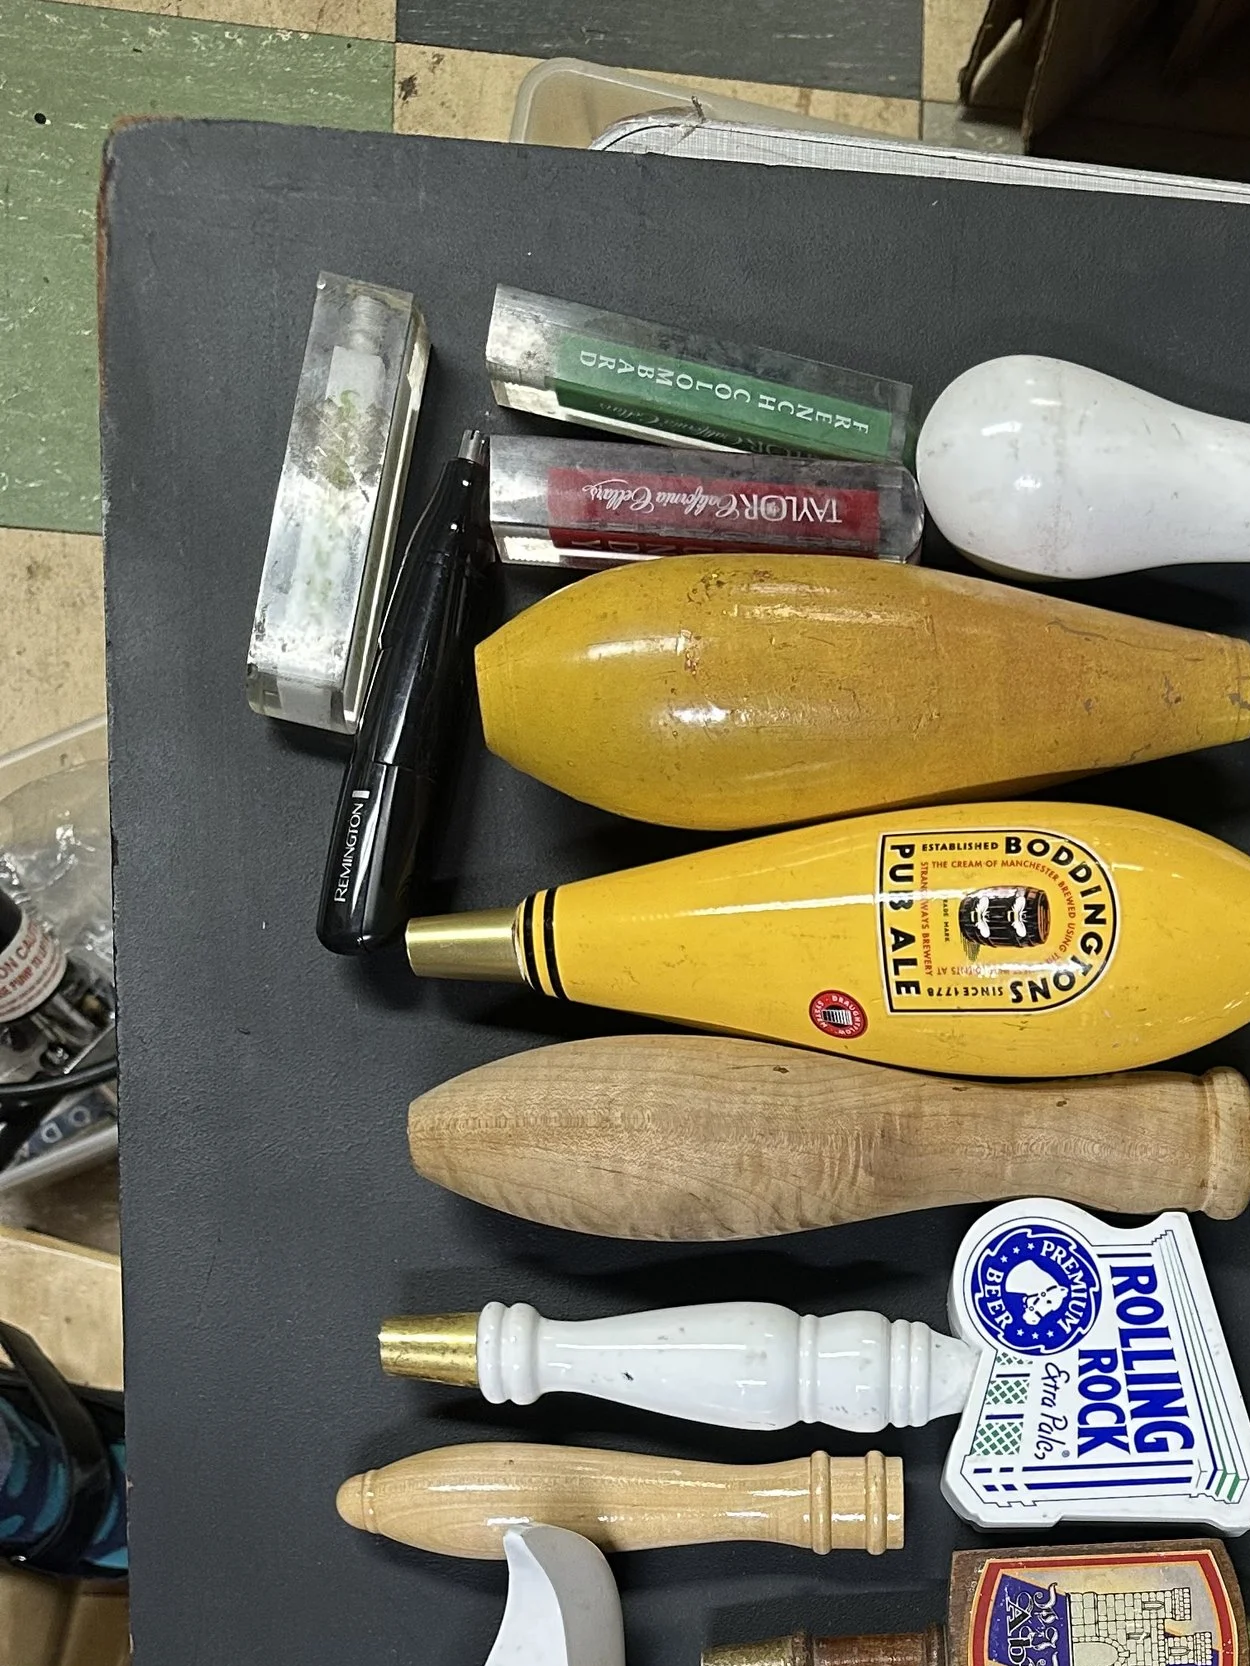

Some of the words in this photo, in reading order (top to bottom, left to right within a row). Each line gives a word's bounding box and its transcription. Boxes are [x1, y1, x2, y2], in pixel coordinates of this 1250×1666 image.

[579, 349, 751, 404] COLOMBARD
[760, 394, 870, 435] FRENCH
[582, 478, 653, 511] Cellars
[656, 484, 741, 521] California
[743, 493, 843, 523] TAYLOR
[333, 802, 364, 903] REMINGTON
[921, 841, 999, 852] ESTABLISHED
[931, 860, 947, 869] THE
[951, 860, 983, 869] CREAM
[985, 860, 998, 868] OF
[888, 844, 916, 911] PUB
[1000, 859, 1060, 881] MANCHESTER
[1004, 836, 1107, 1004] BODDINGTONS
[1058, 880, 1077, 919] BREWED
[921, 932, 933, 977] BREWERY
[1059, 922, 1076, 953] USING
[889, 926, 921, 995] ALE
[927, 986, 960, 997] 1778
[963, 986, 1004, 996] SINCE
[984, 1266, 1014, 1330] BEER
[1040, 1239, 1088, 1334] PREMIUM
[1109, 1263, 1195, 1455] ROLLING
[1039, 1361, 1071, 1408] Extra
[1076, 1348, 1132, 1460] ROCK
[1033, 1412, 1069, 1461] Pale
